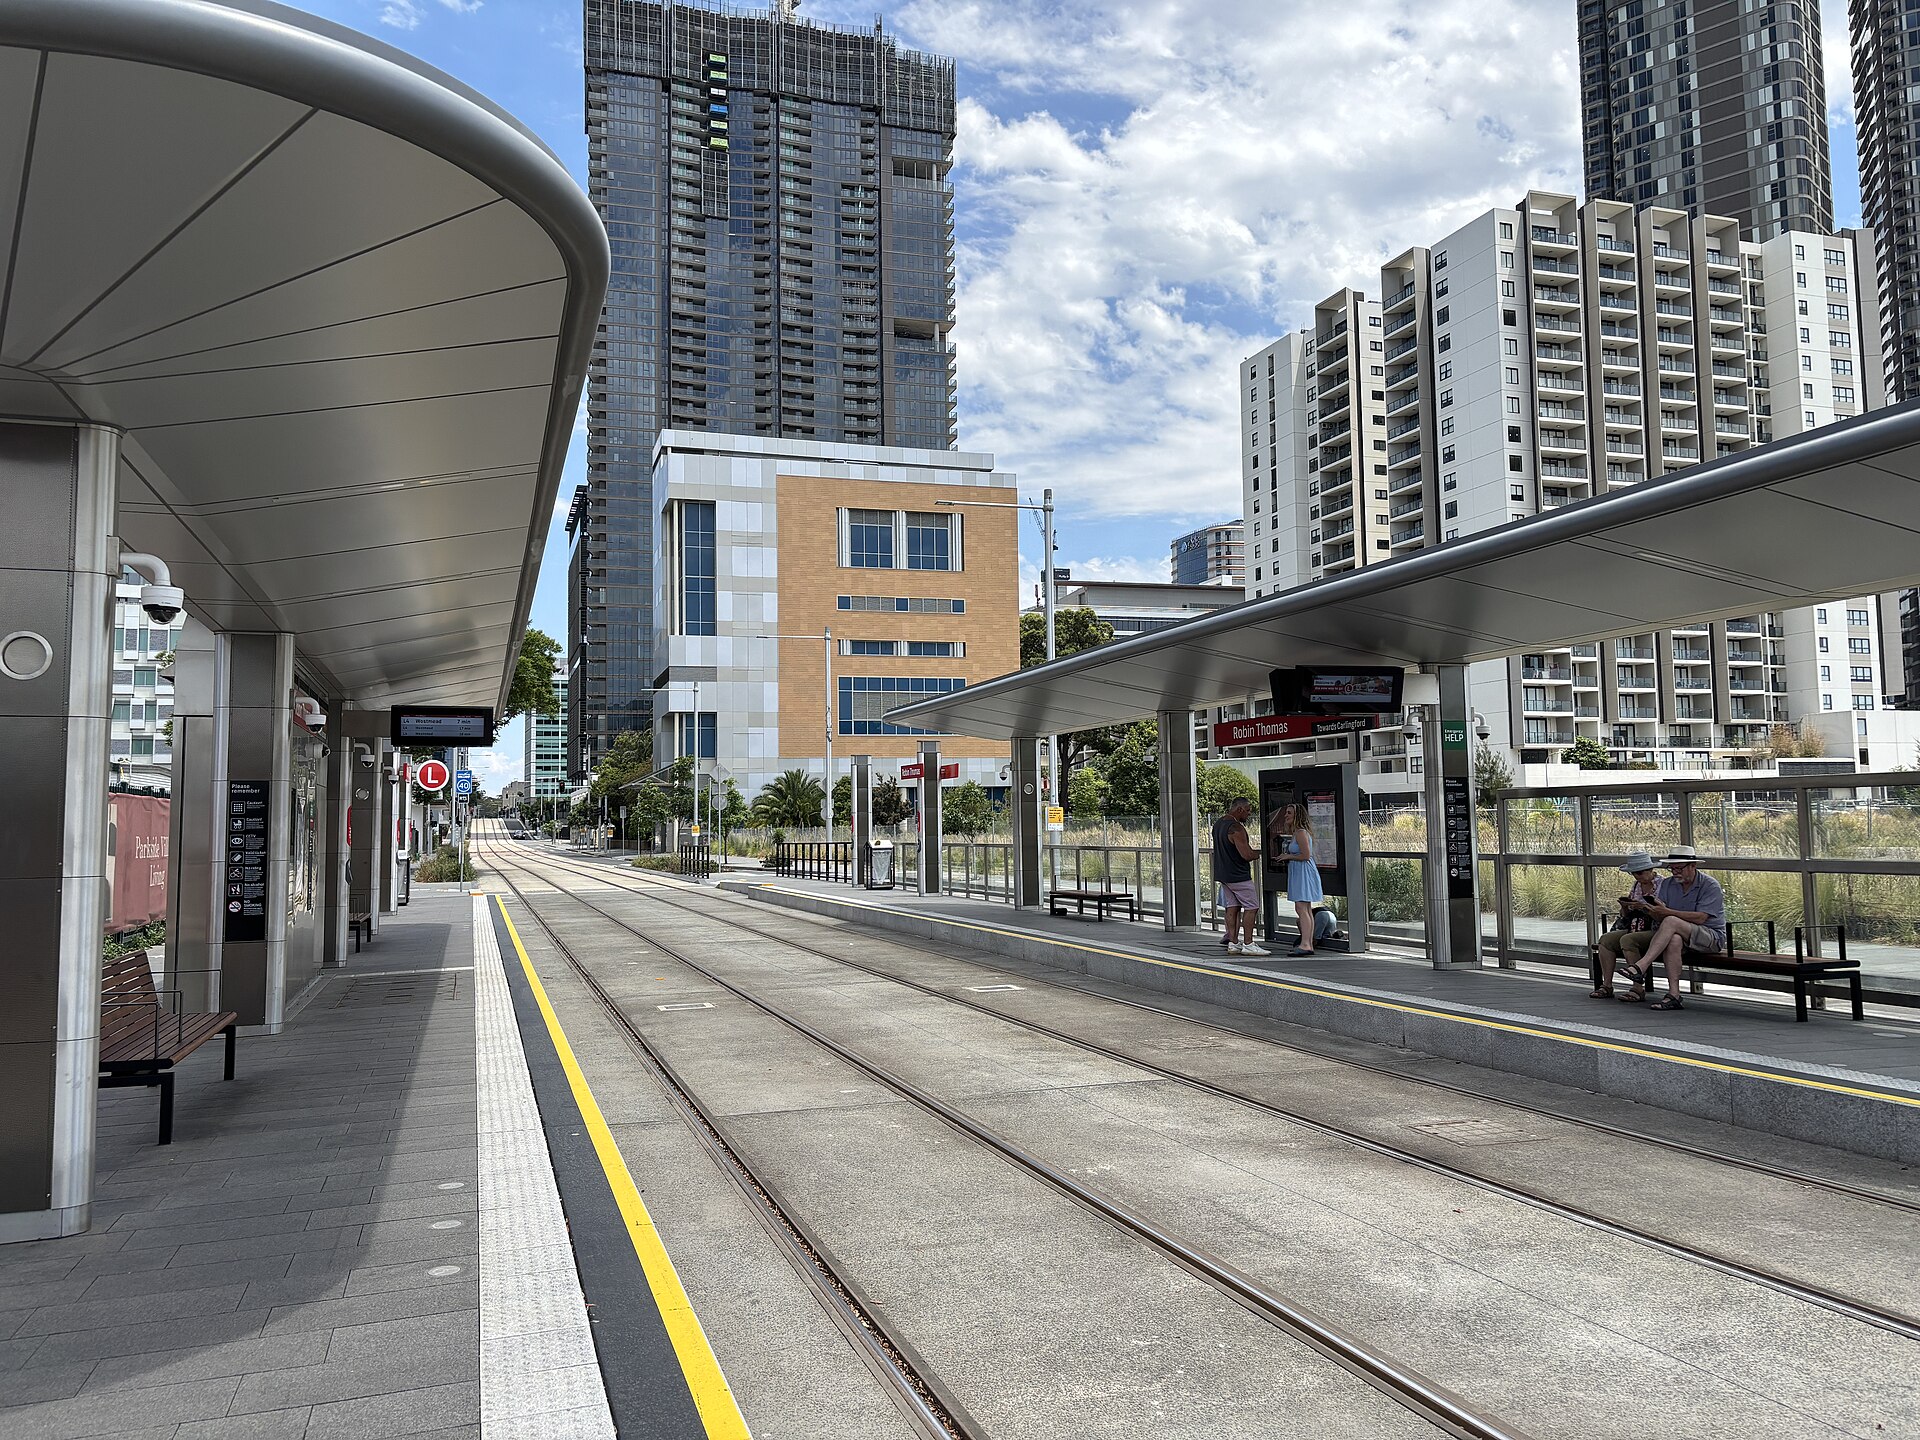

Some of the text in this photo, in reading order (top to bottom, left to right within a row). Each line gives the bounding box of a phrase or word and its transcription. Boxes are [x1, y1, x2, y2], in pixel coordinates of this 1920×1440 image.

[1233, 719, 1366, 740] Robin Thomas Towards Carlingford
[1445, 734, 1464, 742] HELP
[427, 766, 439, 784] L
[135, 836, 160, 859] Parkside
[149, 864, 166, 890] Living
